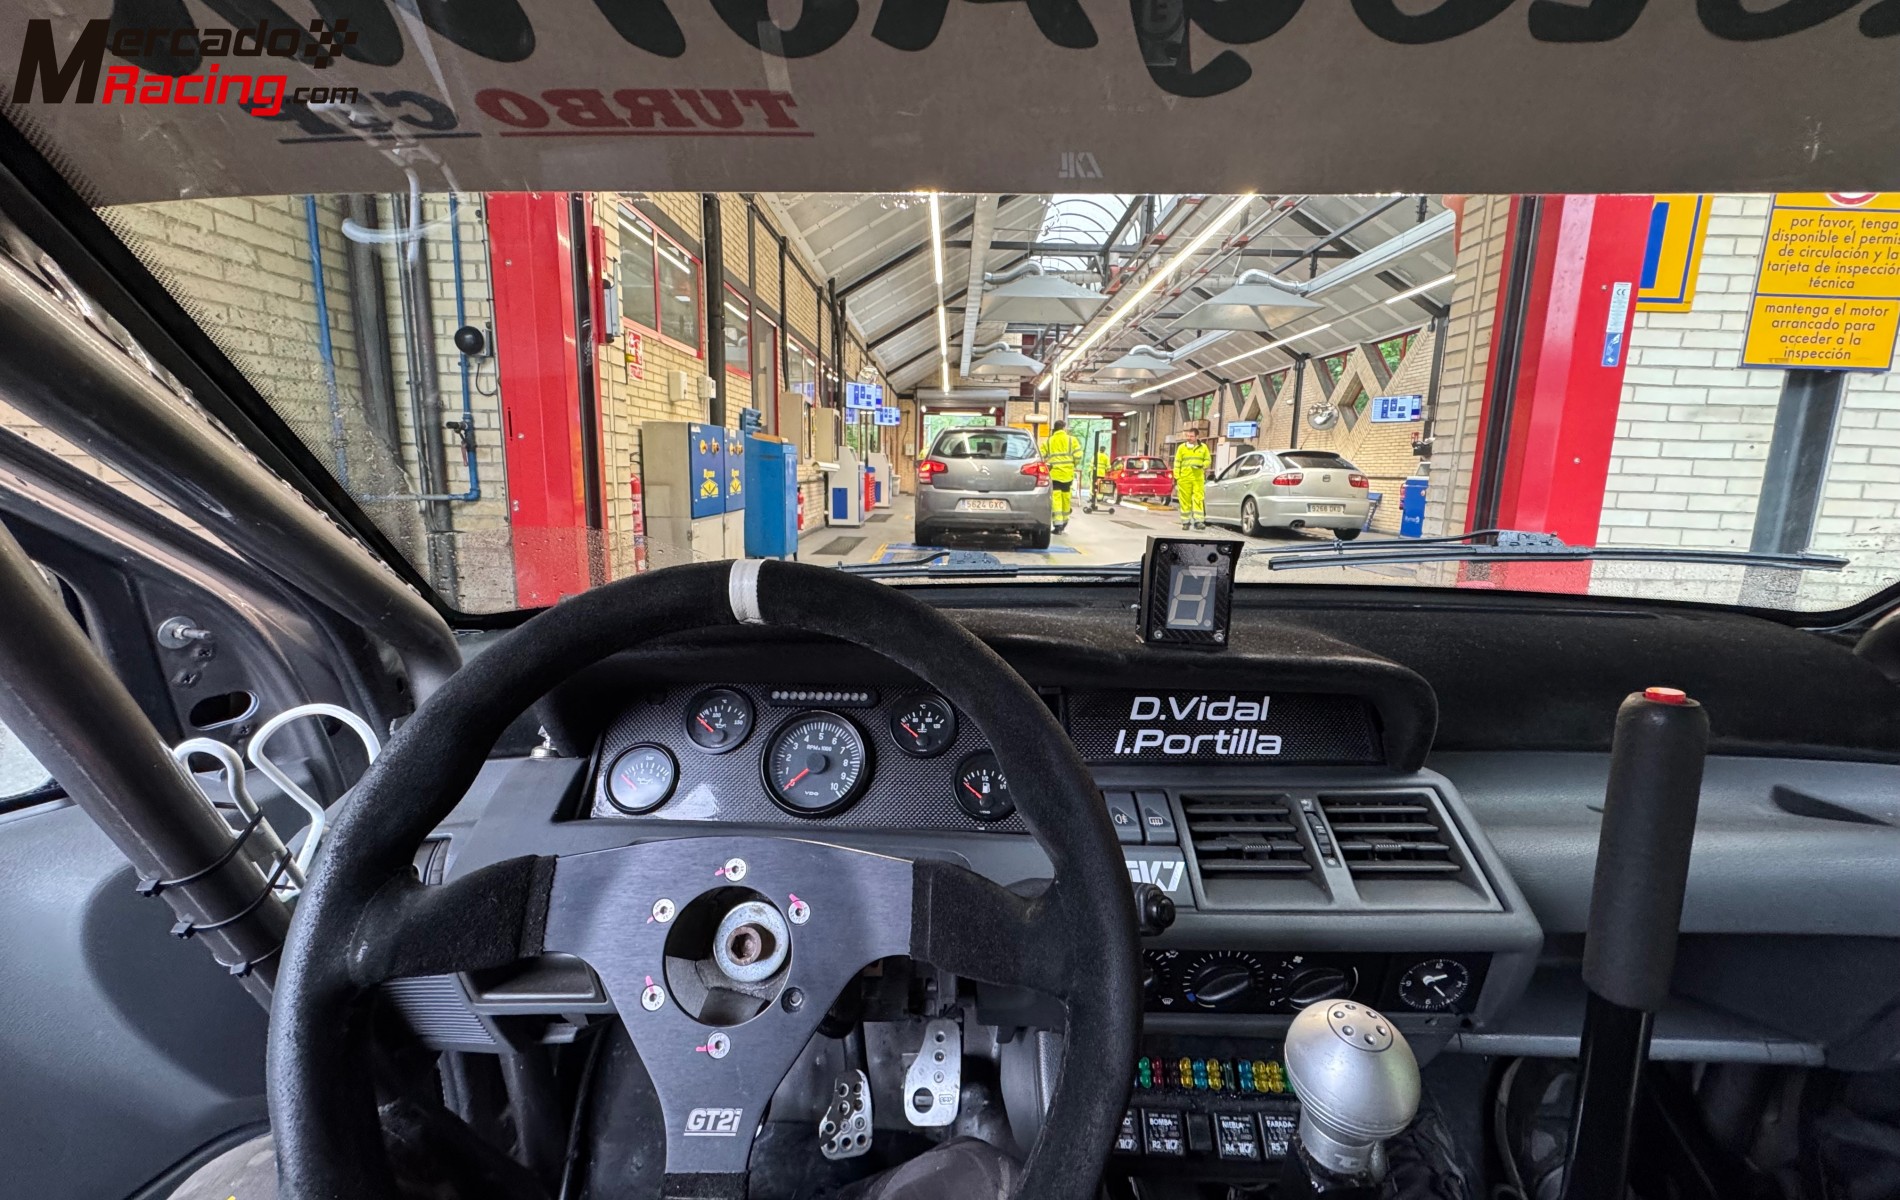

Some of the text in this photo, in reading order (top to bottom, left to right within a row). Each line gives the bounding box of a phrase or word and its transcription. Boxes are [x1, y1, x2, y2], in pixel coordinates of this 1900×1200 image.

[1791, 214, 1898, 232] por favor, tenga
[1772, 228, 1838, 245] disponible
[1844, 230, 1856, 244] el
[1779, 244, 1898, 263] de circulación y la
[1767, 260, 1809, 276] tarjeta
[1815, 260, 1830, 273] de
[1809, 276, 1854, 288] técnica
[1765, 303, 1889, 318] mantenga el motor
[1772, 317, 1875, 333] arrancado para
[1780, 332, 1861, 345] acceder a la
[1784, 347, 1851, 361] inspección
[1130, 696, 1270, 721] D.Vidal
[1114, 728, 1282, 754] I.Portilla
[831, 782, 838, 790] 10
[684, 1108, 743, 1132] GT2i
[1150, 1118, 1172, 1126] BOMBA
